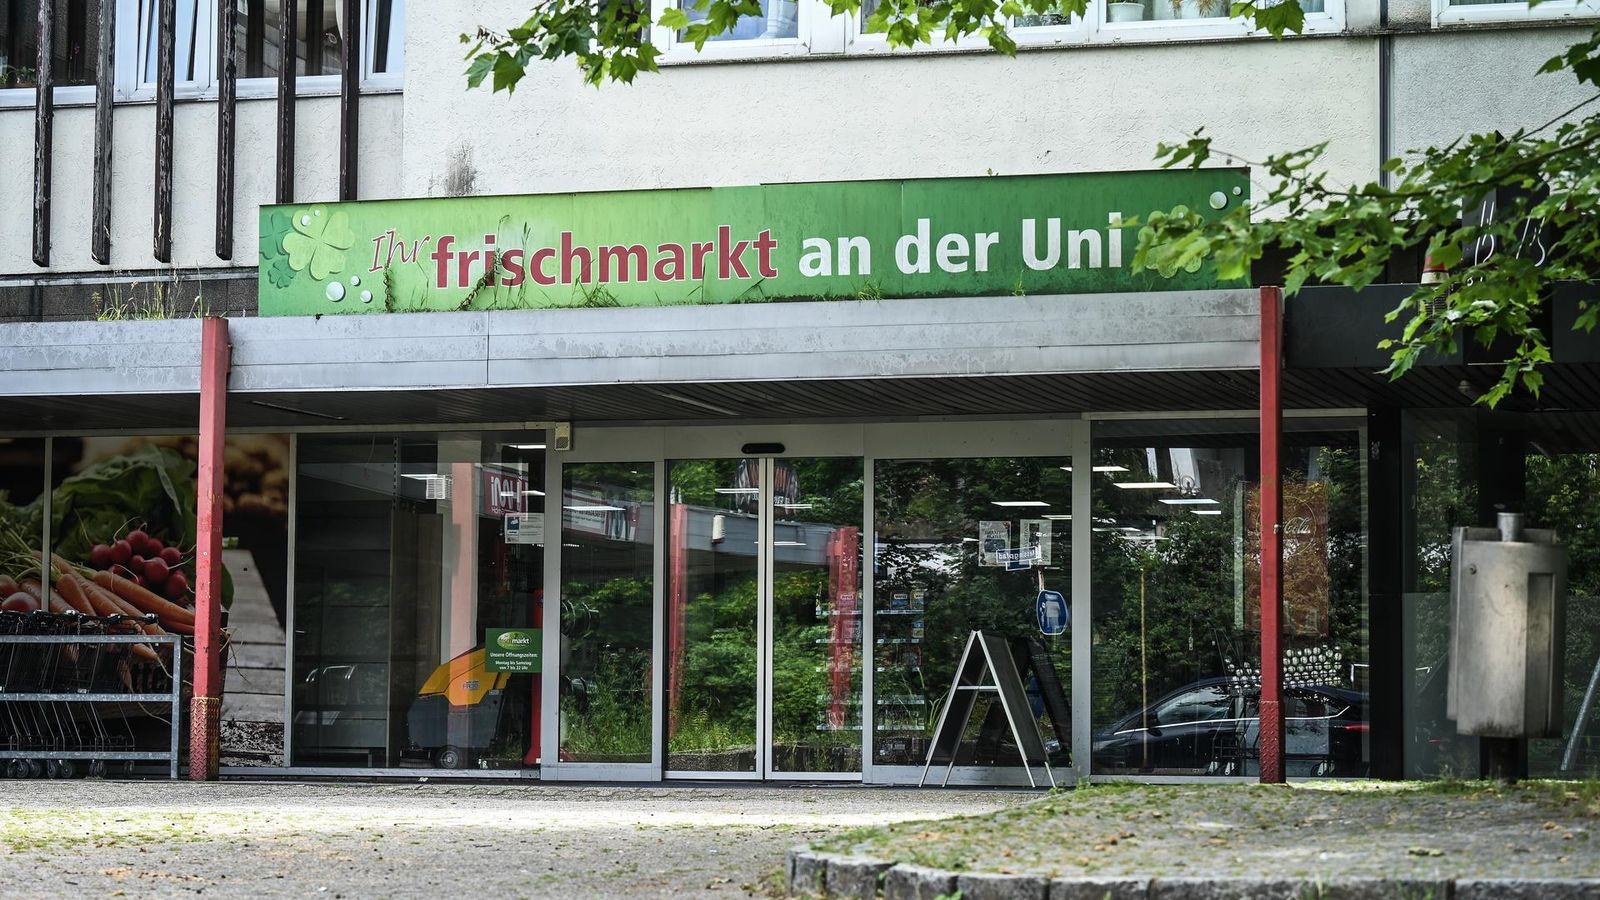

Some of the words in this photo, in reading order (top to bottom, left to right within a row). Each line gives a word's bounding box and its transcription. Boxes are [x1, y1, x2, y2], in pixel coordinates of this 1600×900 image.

[368, 227, 431, 273] Ihr
[431, 225, 778, 289] frischmarkt
[798, 234, 872, 278] an
[894, 218, 999, 275] der
[1021, 212, 1123, 272] Uni
